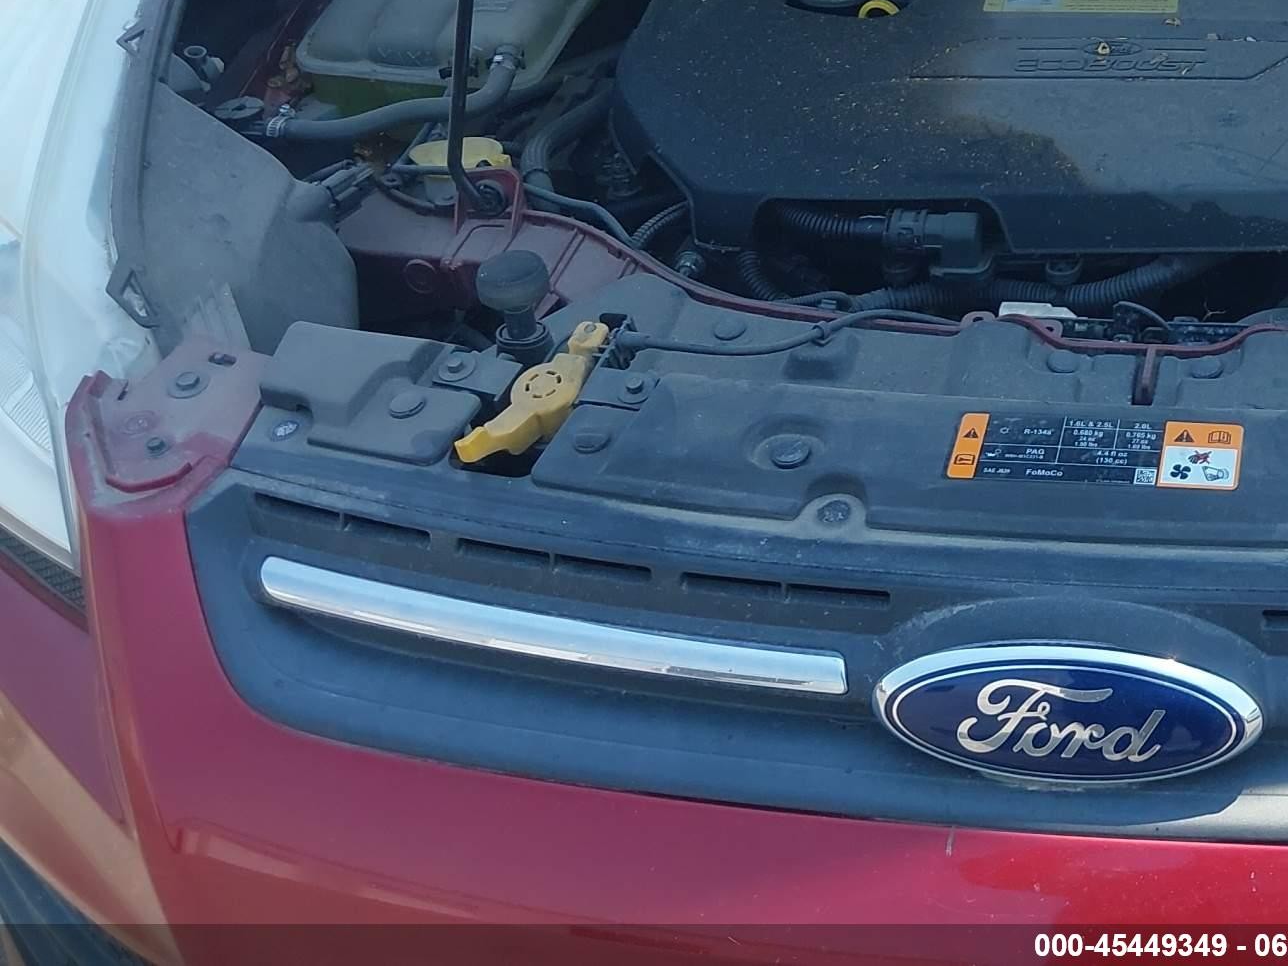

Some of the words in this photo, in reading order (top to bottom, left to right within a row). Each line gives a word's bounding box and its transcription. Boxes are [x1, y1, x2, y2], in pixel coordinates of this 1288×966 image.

[1023, 428, 1053, 436] R-134a
[1025, 468, 1063, 477] FoMoCo
[956, 678, 1167, 763] Ford
